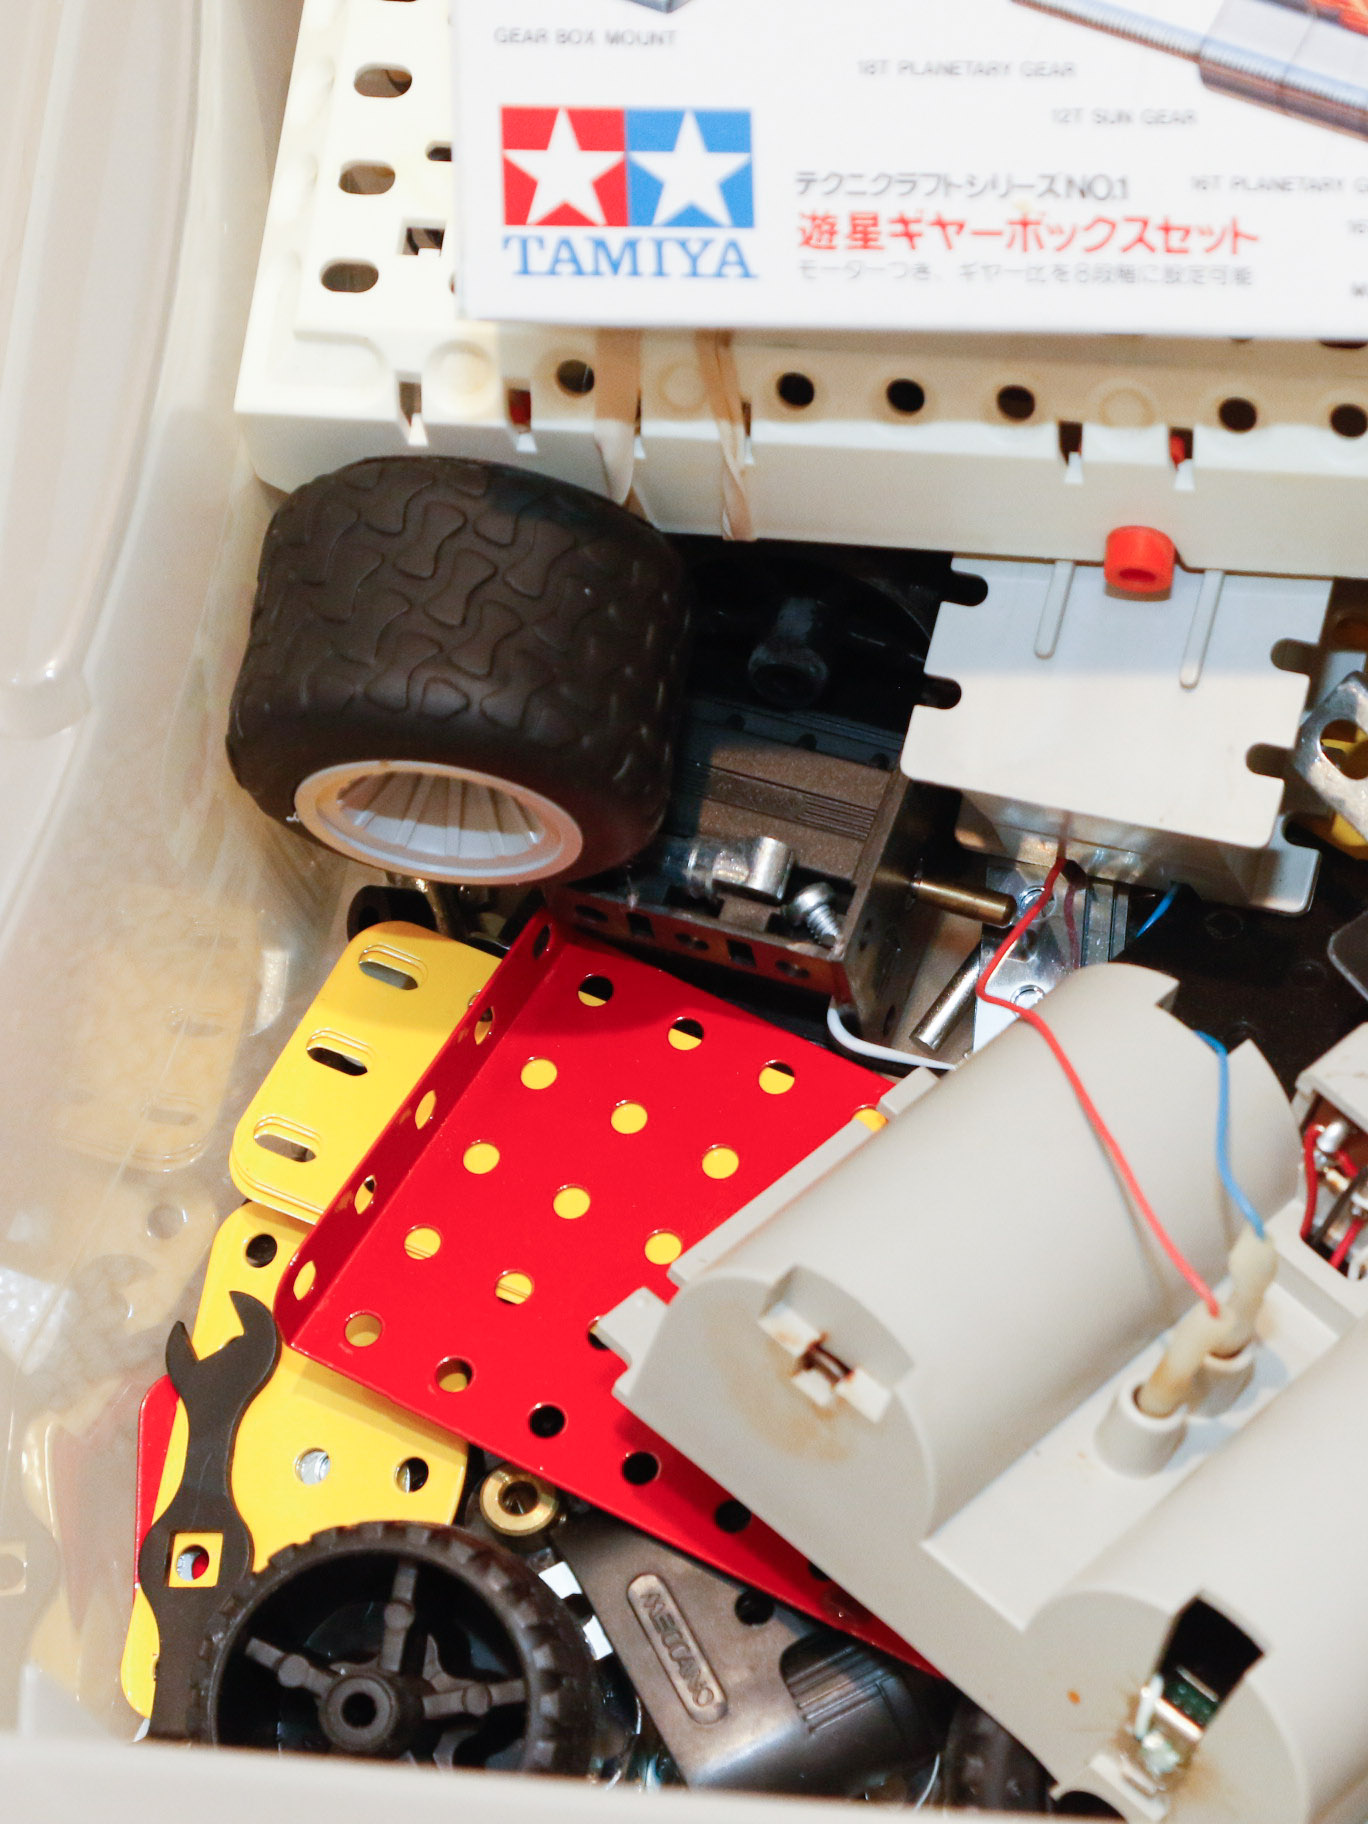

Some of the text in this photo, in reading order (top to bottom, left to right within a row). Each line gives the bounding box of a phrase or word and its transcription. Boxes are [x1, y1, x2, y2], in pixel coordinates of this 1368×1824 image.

[494, 28, 677, 47] GEAR BOX MOUNT
[898, 61, 1012, 77] PLANETARY
[1021, 62, 1077, 78] GEAR
[1093, 108, 1134, 126] SUN
[1142, 109, 1198, 127] GEAR
[1230, 177, 1345, 193] PLANETARY
[798, 210, 1260, 256] 遊星ギヤーボックスセット
[502, 235, 758, 279] TAMIYA
[641, 1591, 715, 1707] MECCANO
